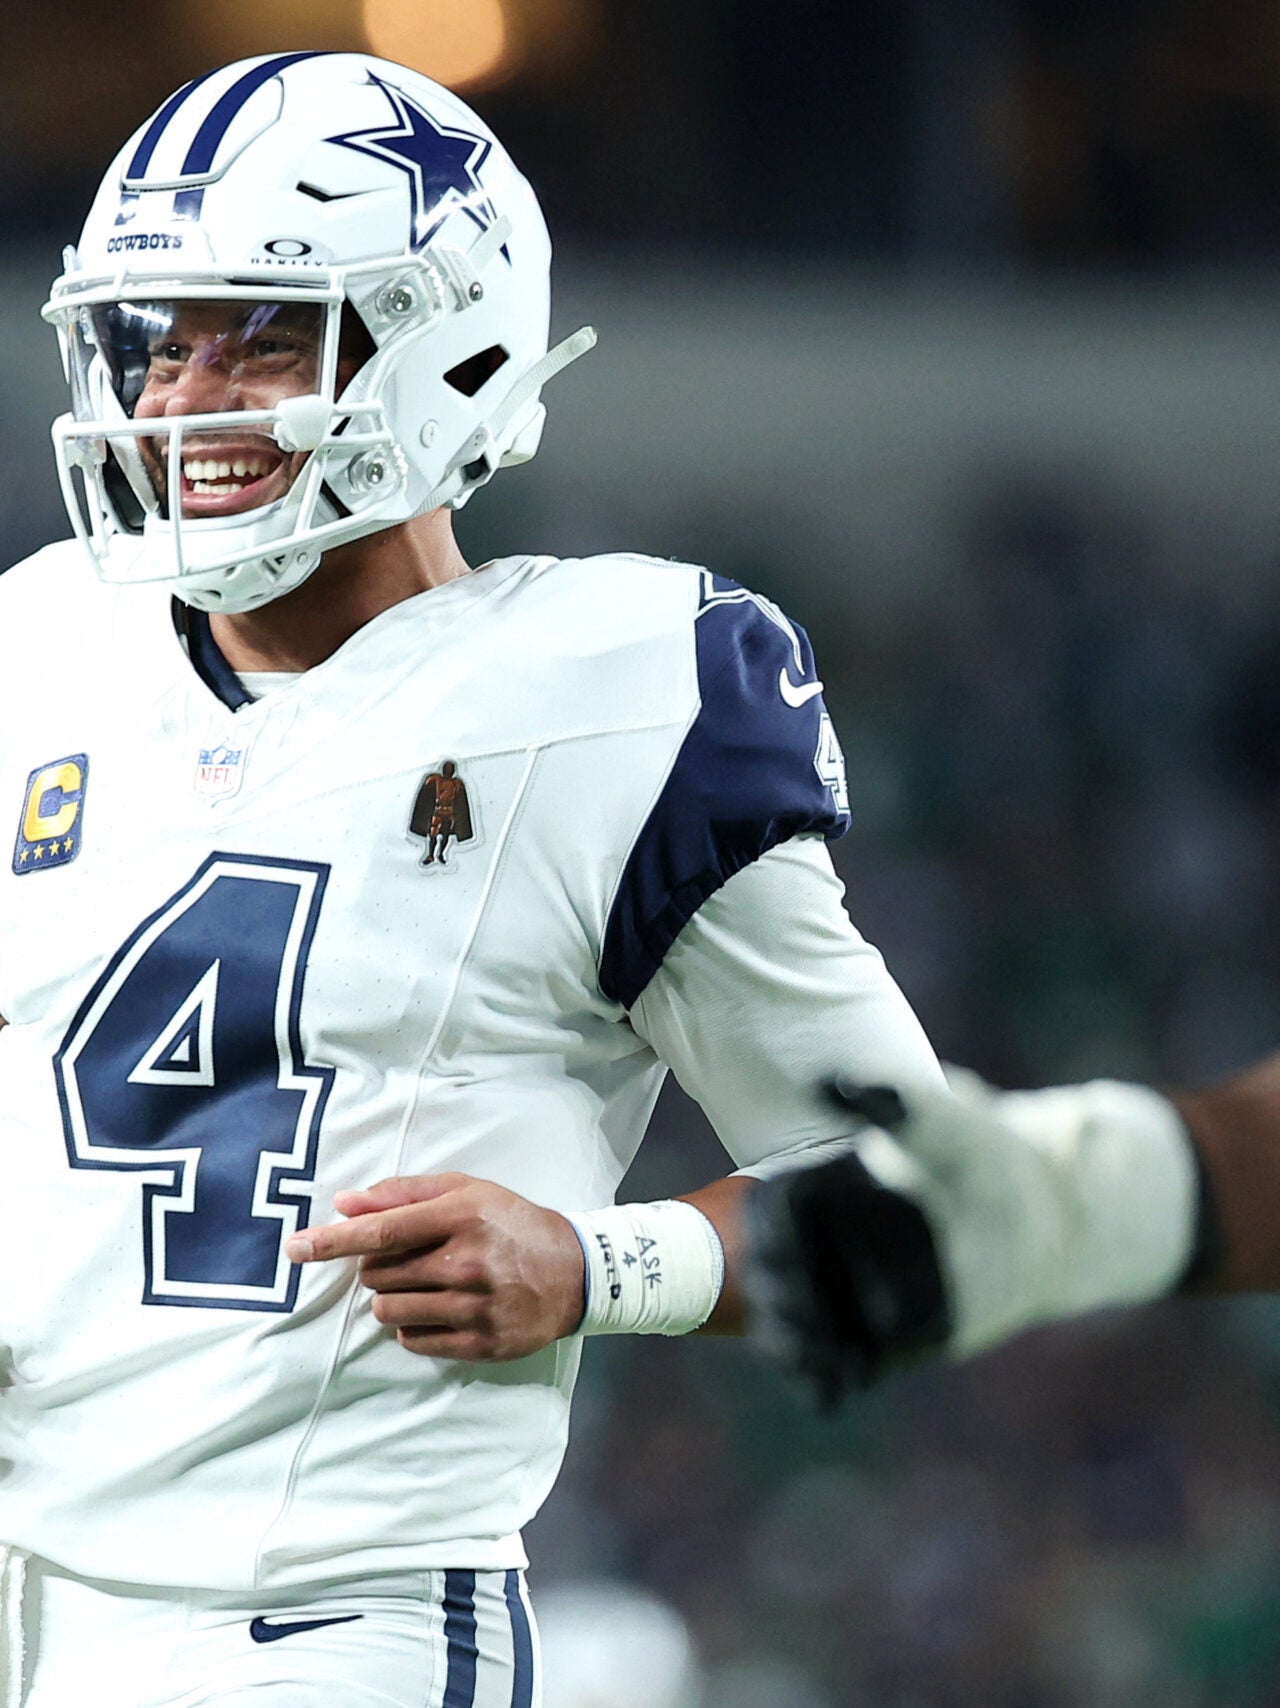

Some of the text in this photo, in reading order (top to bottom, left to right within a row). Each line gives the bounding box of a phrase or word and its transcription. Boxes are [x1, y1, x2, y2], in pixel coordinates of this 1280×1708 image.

[107, 233, 183, 253] COWBOYS
[22, 761, 82, 842] C
[813, 711, 851, 815] 4
[52, 850, 336, 1313] 4
[635, 1236, 662, 1290] ASK
